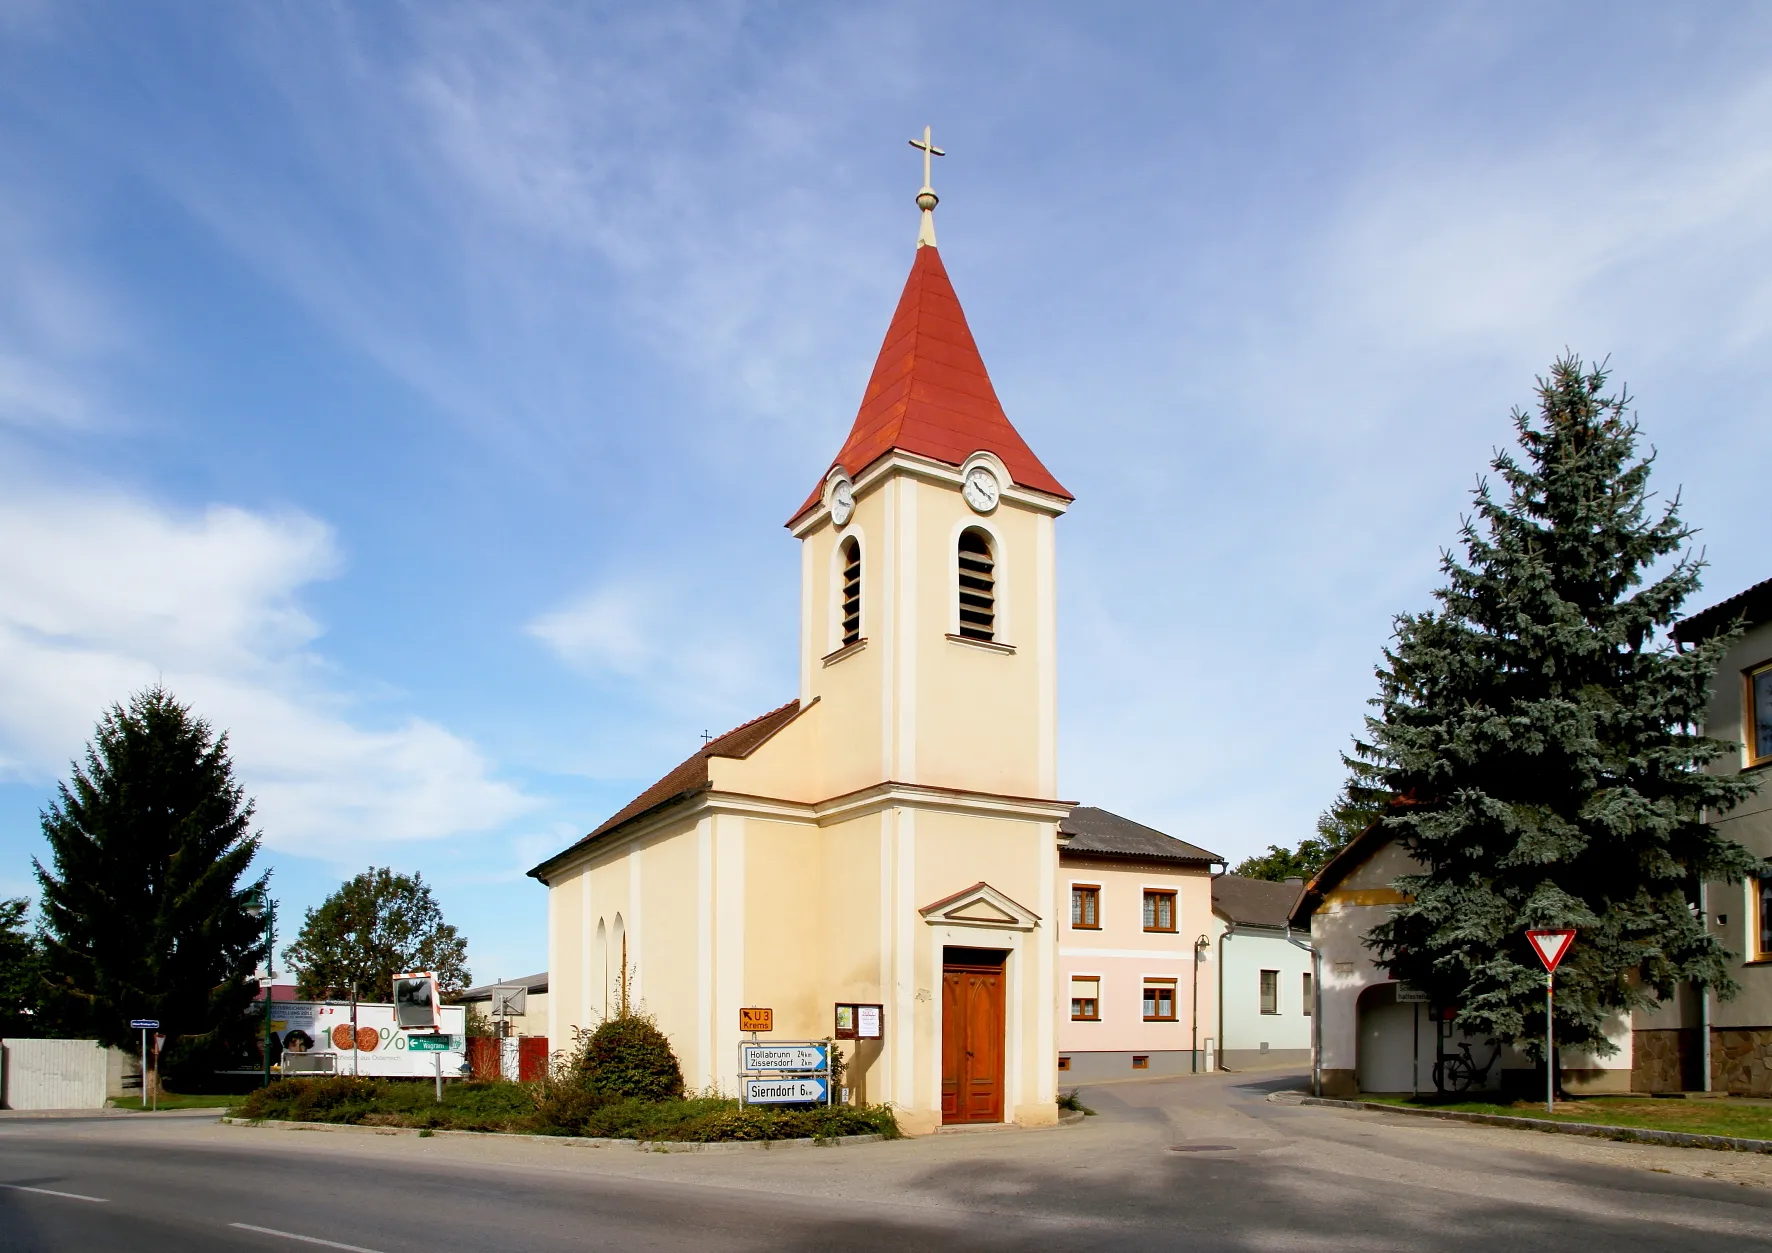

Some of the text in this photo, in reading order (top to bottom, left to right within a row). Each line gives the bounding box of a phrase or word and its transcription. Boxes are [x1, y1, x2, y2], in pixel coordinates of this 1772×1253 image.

[754, 1011, 769, 1020] U 3
[423, 1042, 445, 1050] Wagram
[750, 1059, 794, 1067] Zissersdorf
[751, 1084, 796, 1098] Sierndorf
